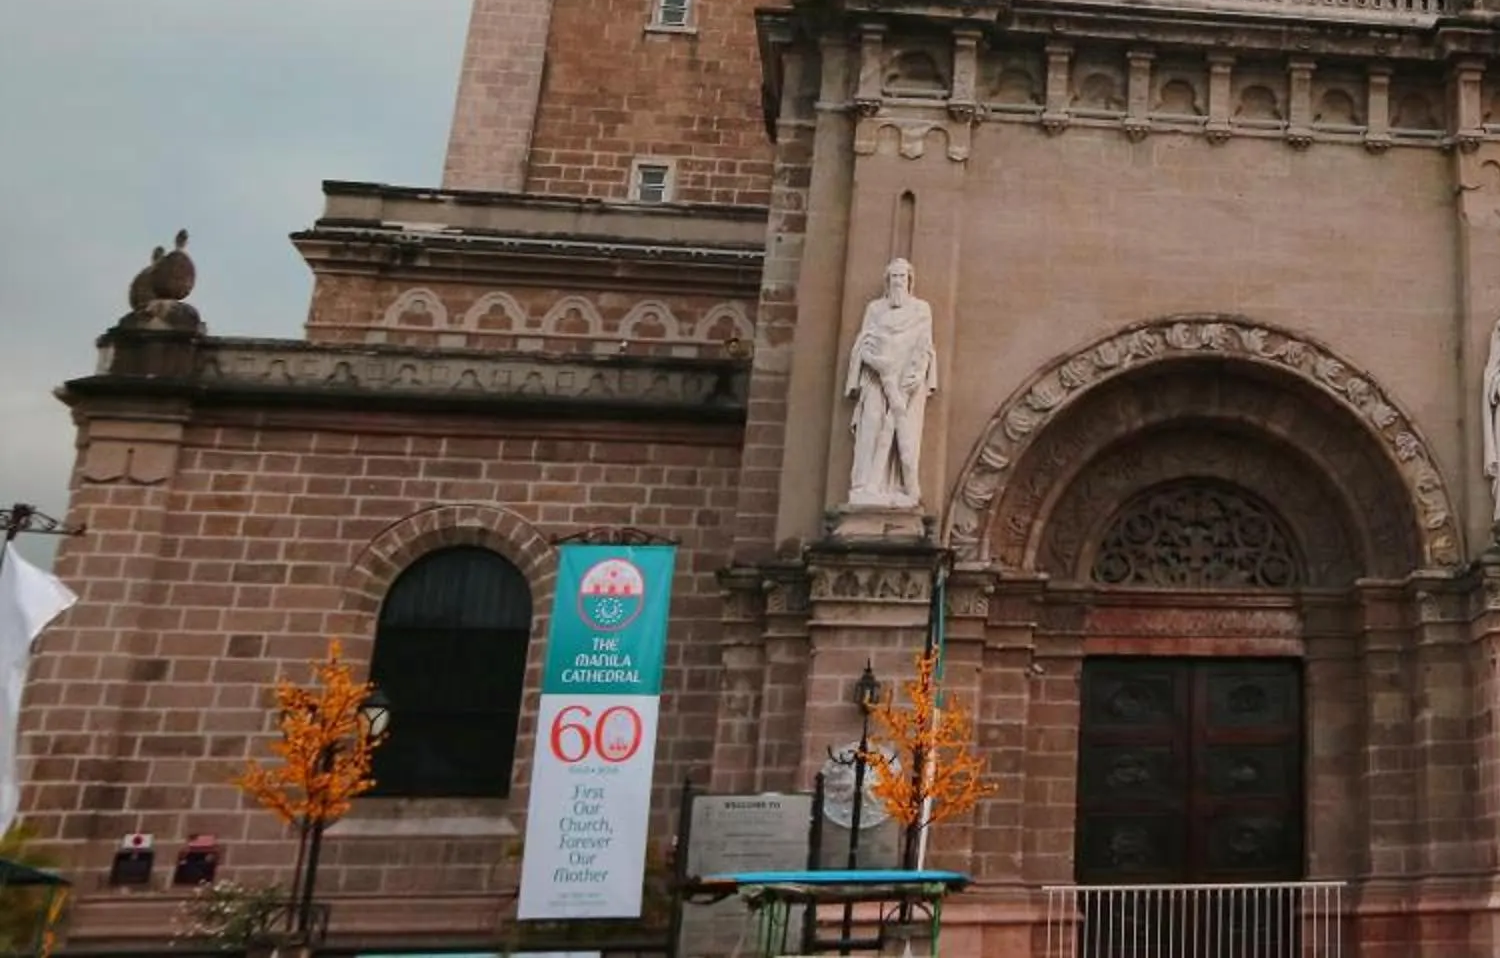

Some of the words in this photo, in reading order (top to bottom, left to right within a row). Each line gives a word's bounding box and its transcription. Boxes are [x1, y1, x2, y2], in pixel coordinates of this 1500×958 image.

[592, 637, 619, 651] THE
[575, 653, 632, 667] MANILA
[561, 669, 641, 683] CATHEDRAL
[549, 705, 643, 763] 60
[571, 785, 605, 800] First
[573, 801, 601, 816] Our
[559, 817, 614, 834] Church,
[558, 834, 613, 849] Forever
[569, 851, 597, 866] Our
[553, 868, 609, 883] Mother
